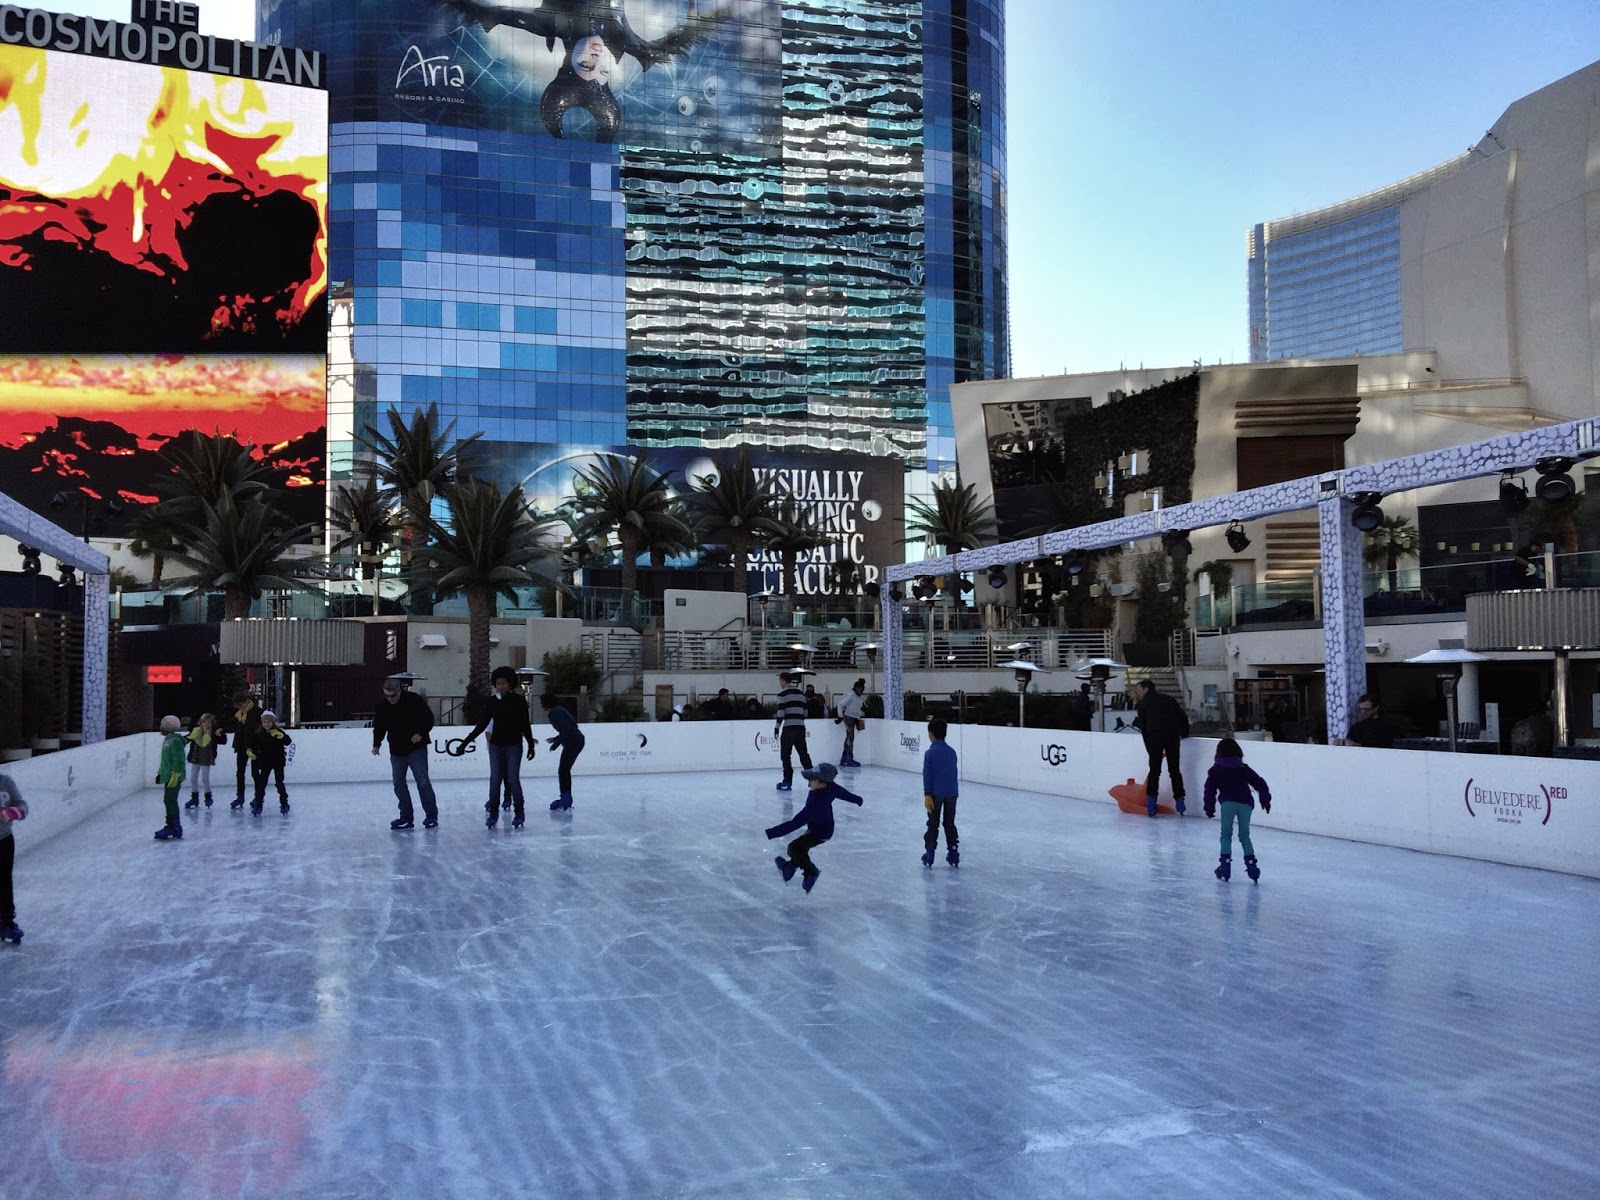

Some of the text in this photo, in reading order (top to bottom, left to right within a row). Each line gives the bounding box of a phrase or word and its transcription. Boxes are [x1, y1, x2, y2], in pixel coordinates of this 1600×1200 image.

[139, 0, 197, 26] THE
[0, 4, 321, 87] COSMOPOLITAN
[395, 45, 465, 89] Aria
[394, 94, 426, 102] RESORT
[435, 96, 465, 104] CASINO
[752, 468, 864, 502] VISUALLY
[434, 738, 477, 757] UGG
[1040, 744, 1068, 766] UGG
[1474, 786, 1568, 811] BELVEDERE RED
[1494, 806, 1523, 817] VODKA
